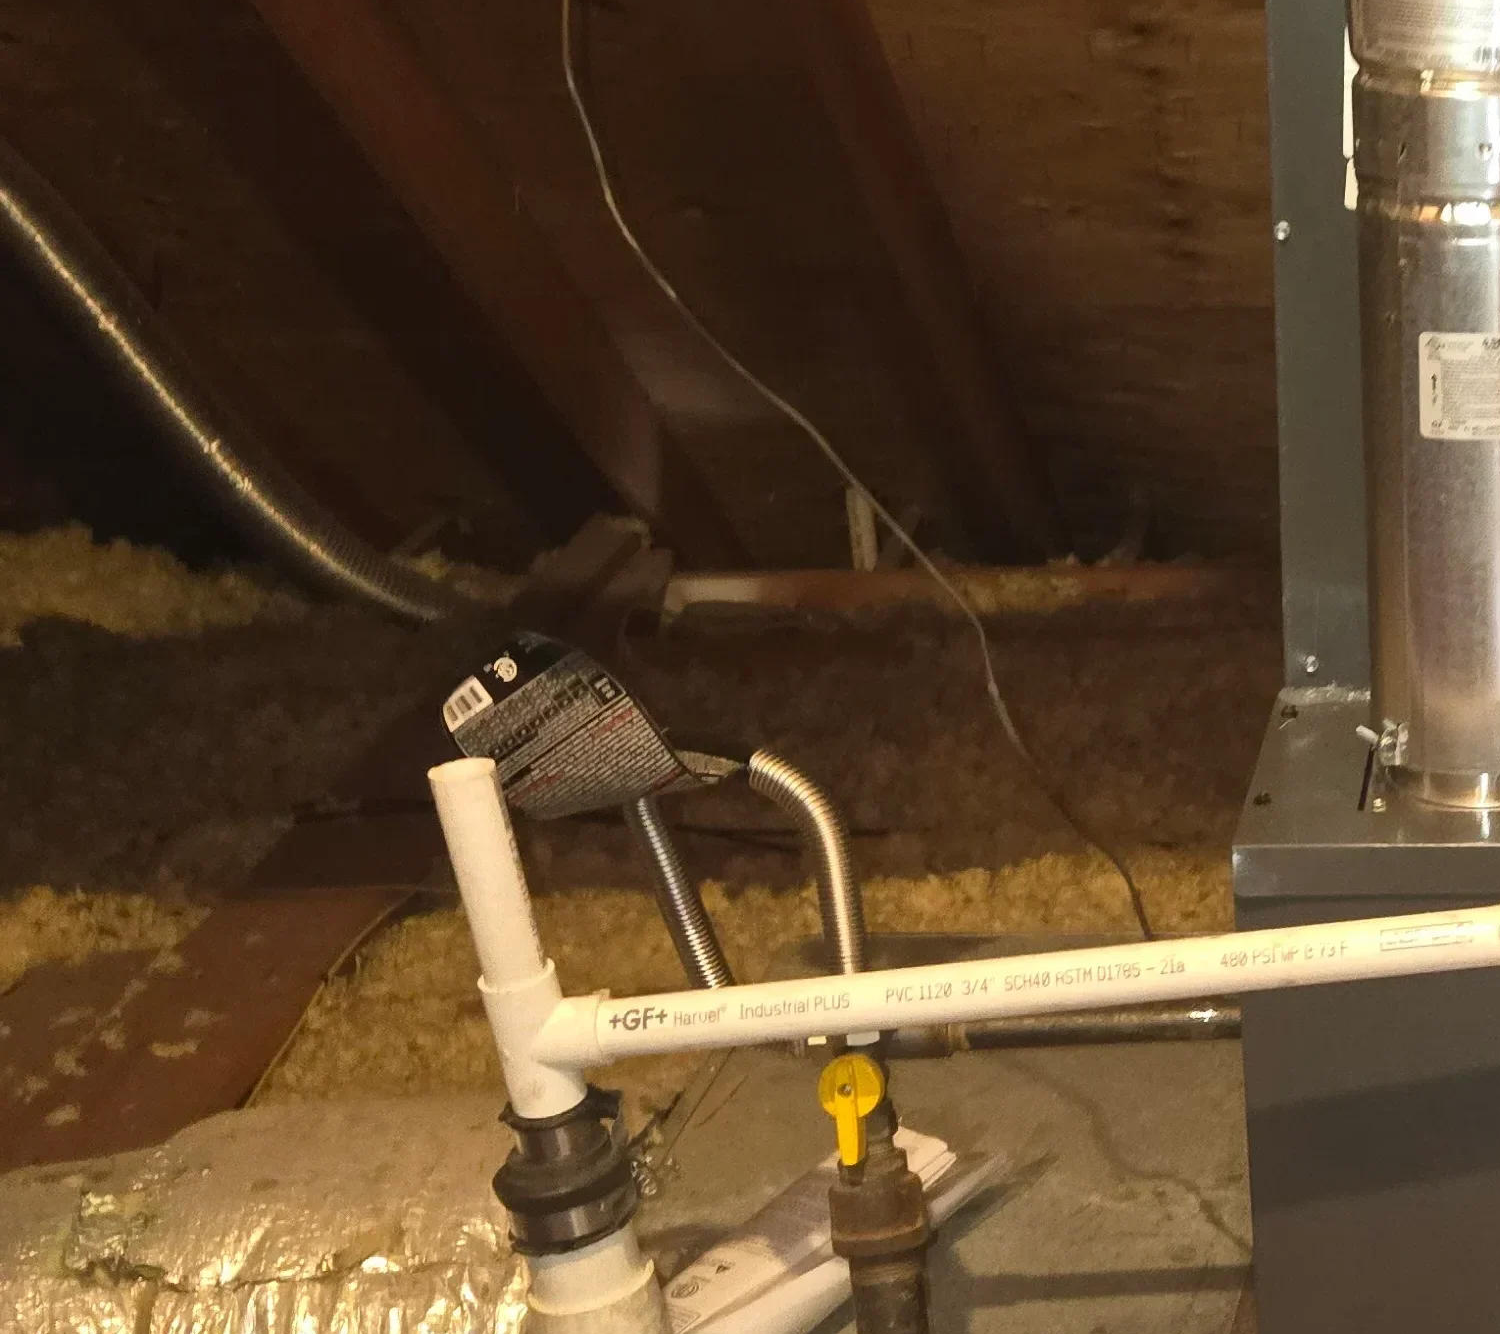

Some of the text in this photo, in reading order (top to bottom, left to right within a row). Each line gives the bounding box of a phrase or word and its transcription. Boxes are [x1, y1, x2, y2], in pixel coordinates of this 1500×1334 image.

[608, 1007, 669, 1031] +GF+
[738, 997, 810, 1020] Industrial
[814, 992, 851, 1011] PLUS
[885, 985, 914, 1004] PVC
[919, 982, 953, 1001] 1120
[1055, 967, 1094, 987] ASTM
